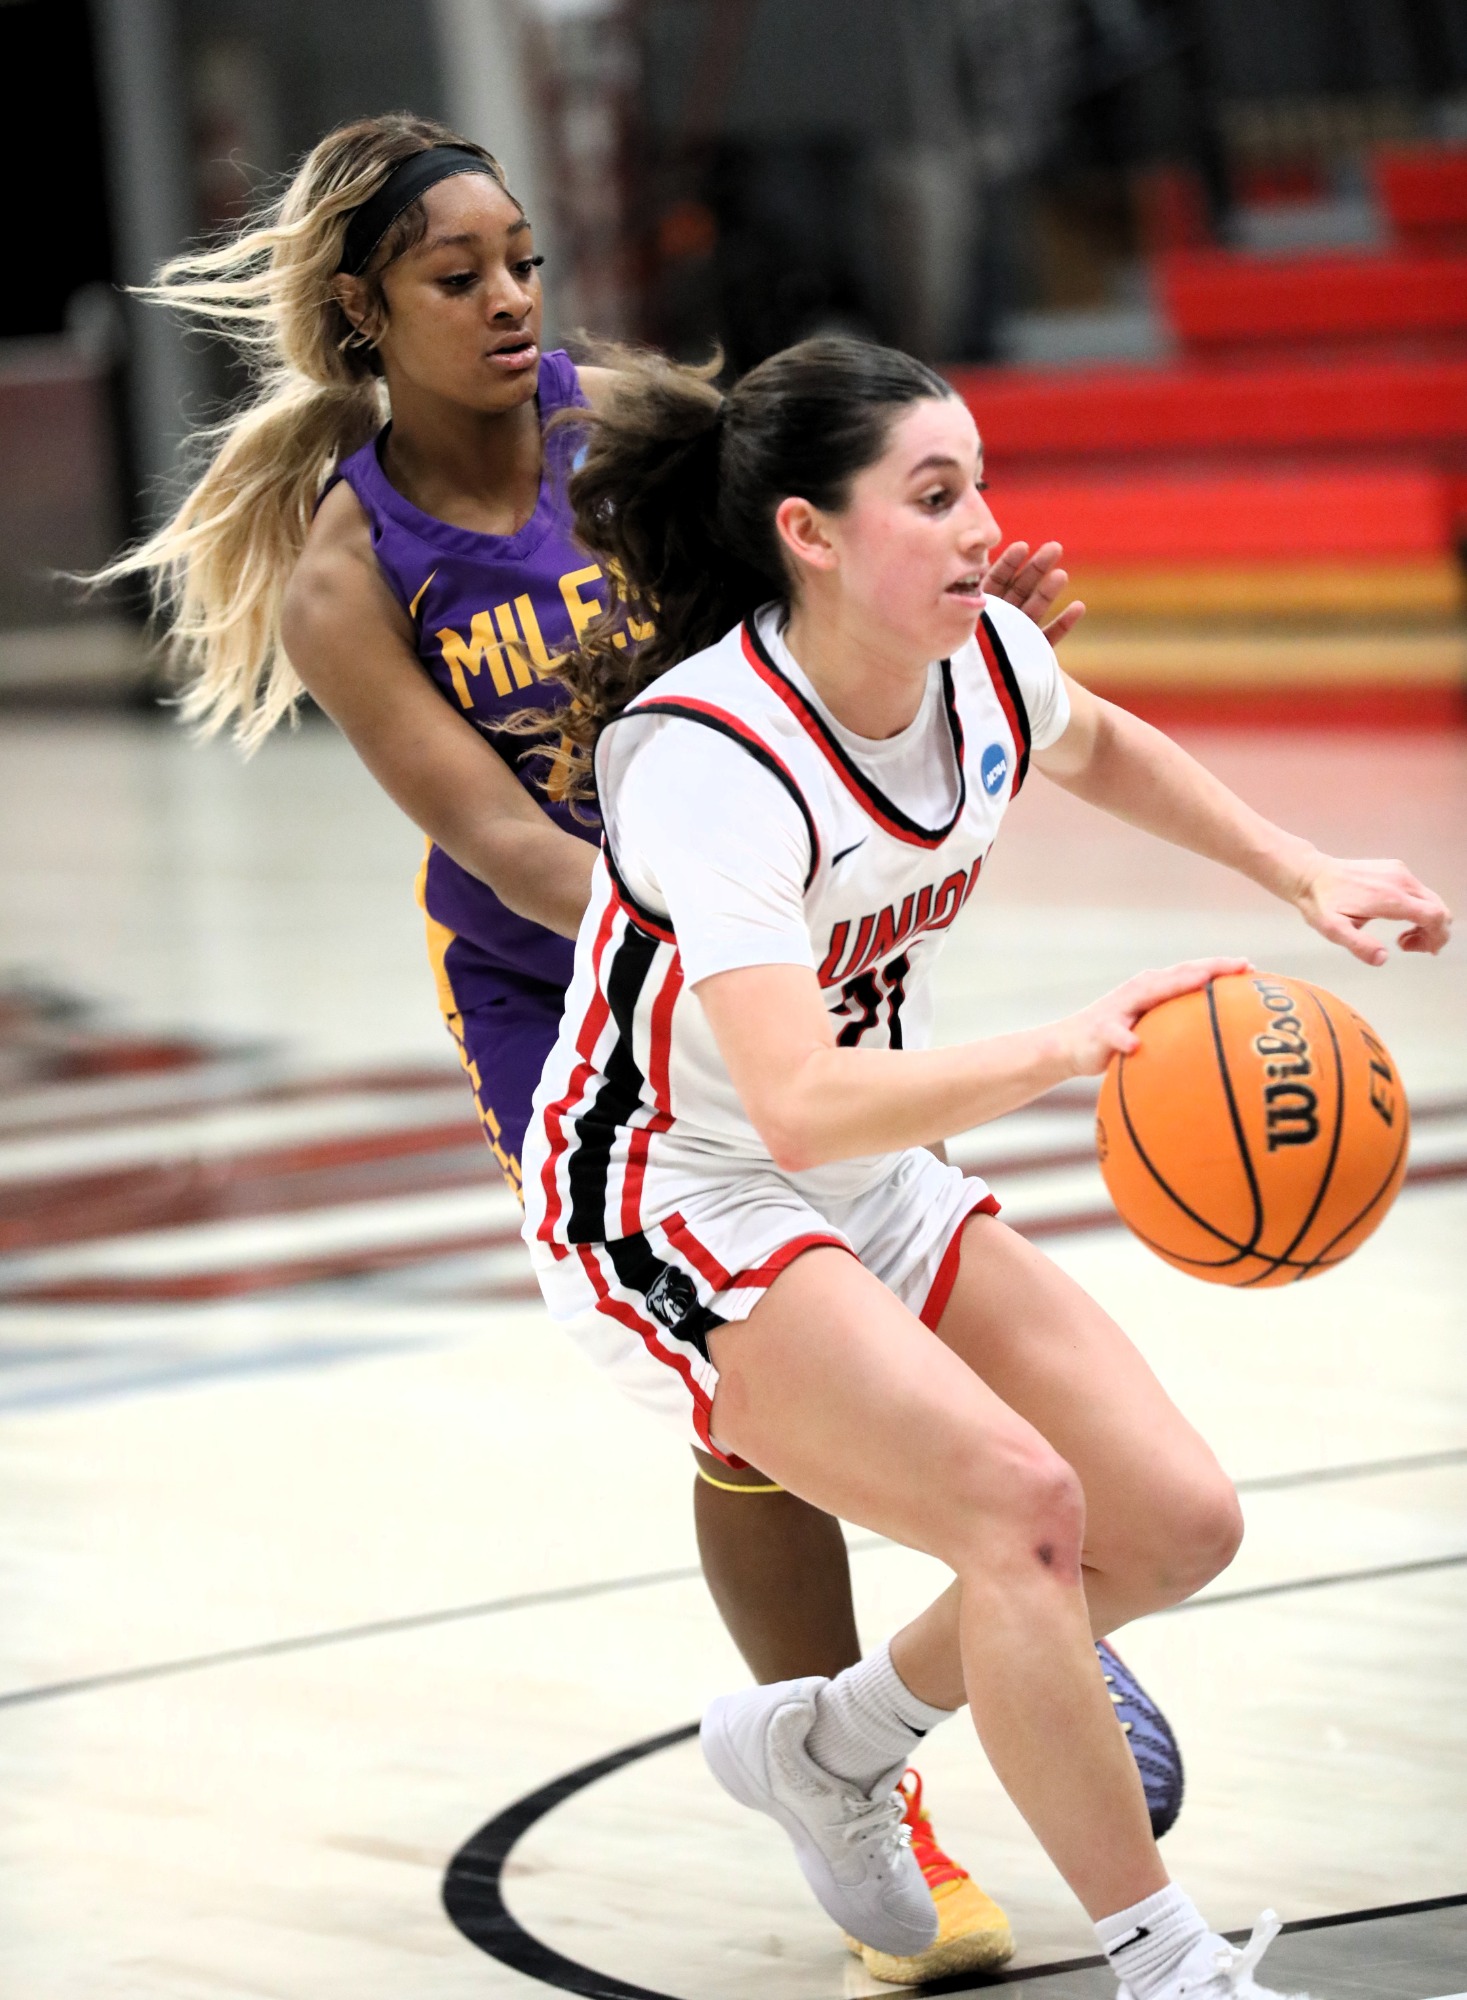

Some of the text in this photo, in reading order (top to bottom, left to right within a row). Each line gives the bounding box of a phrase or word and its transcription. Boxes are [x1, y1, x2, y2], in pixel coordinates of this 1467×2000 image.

[828, 945, 912, 1051] 21
[1251, 979, 1320, 1153] Wilson
[1351, 1012, 1394, 1128] EV
